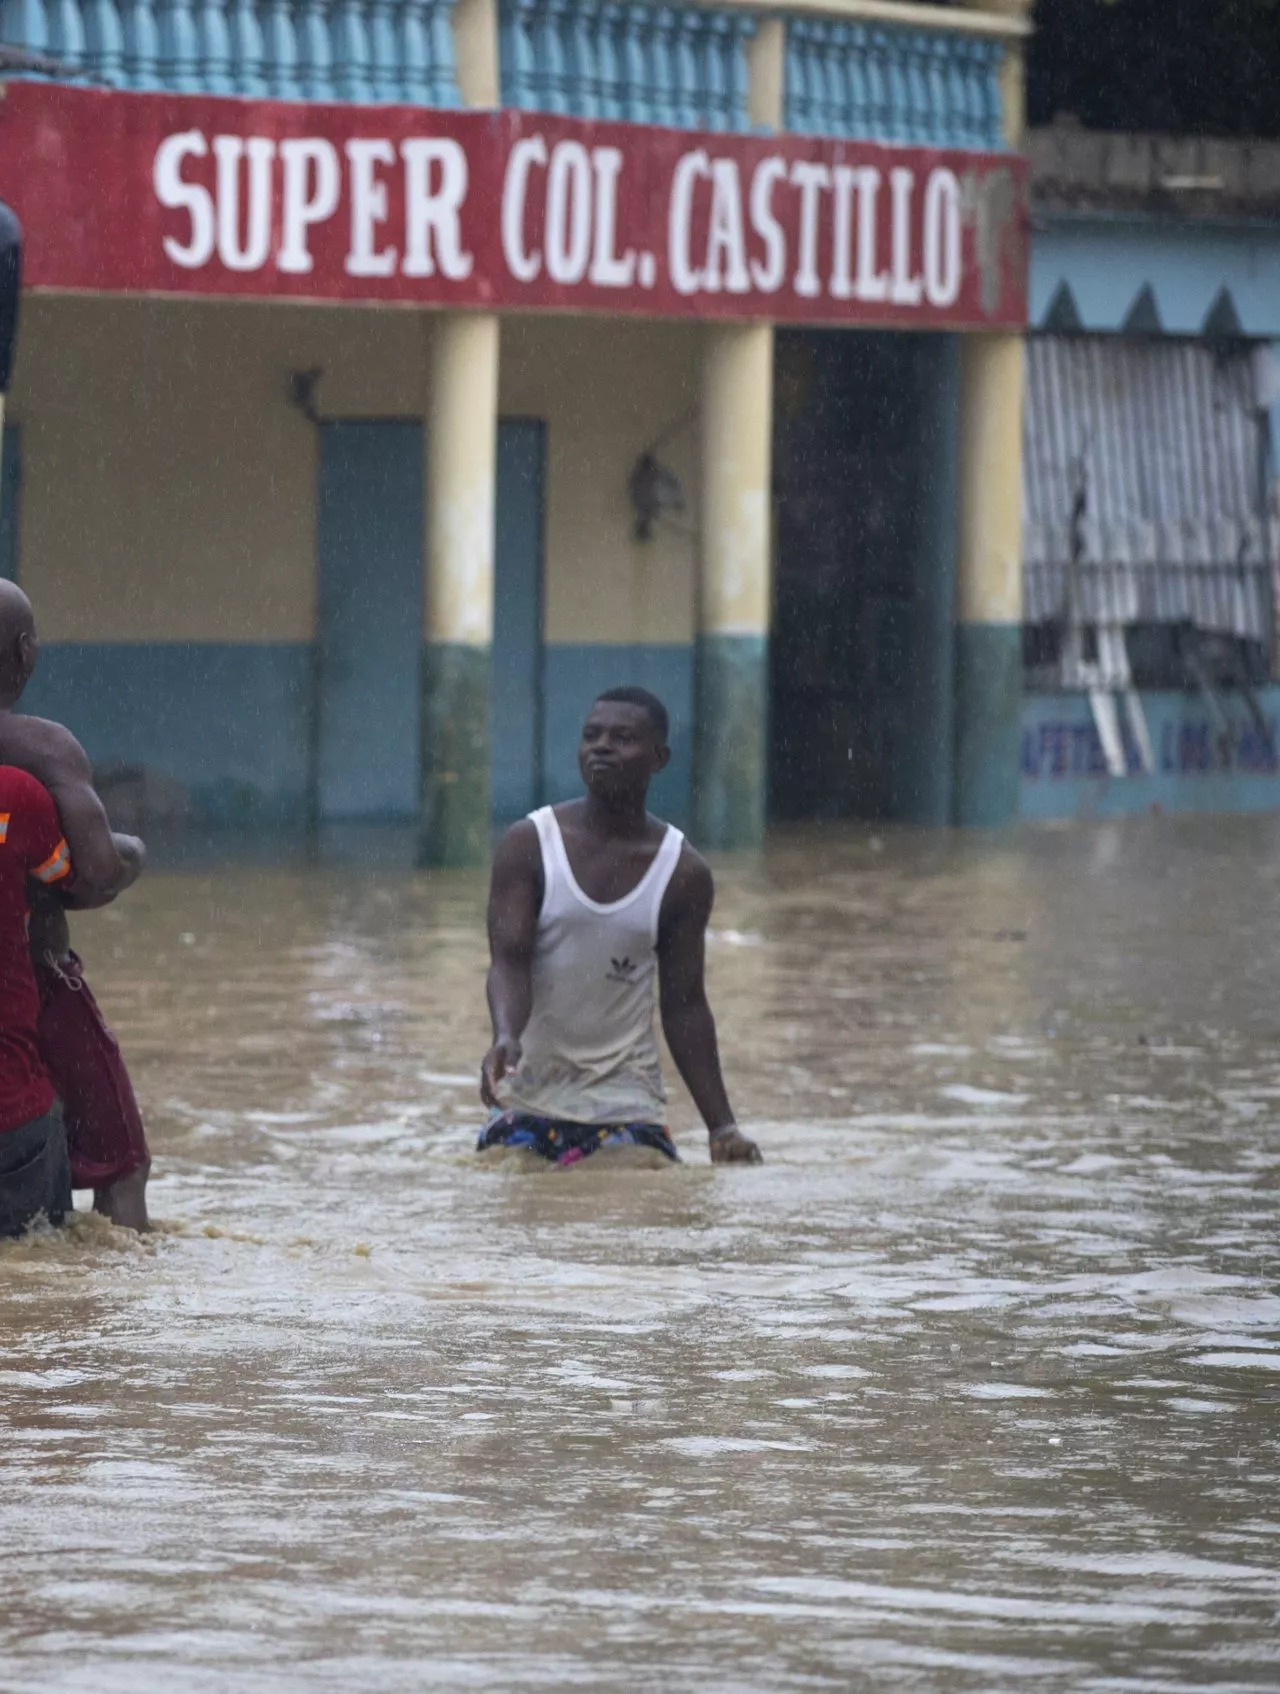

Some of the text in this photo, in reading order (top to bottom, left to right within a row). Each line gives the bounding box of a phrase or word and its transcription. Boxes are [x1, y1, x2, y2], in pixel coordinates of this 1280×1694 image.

[152, 129, 961, 307] SUPER COL. CASTILLO
